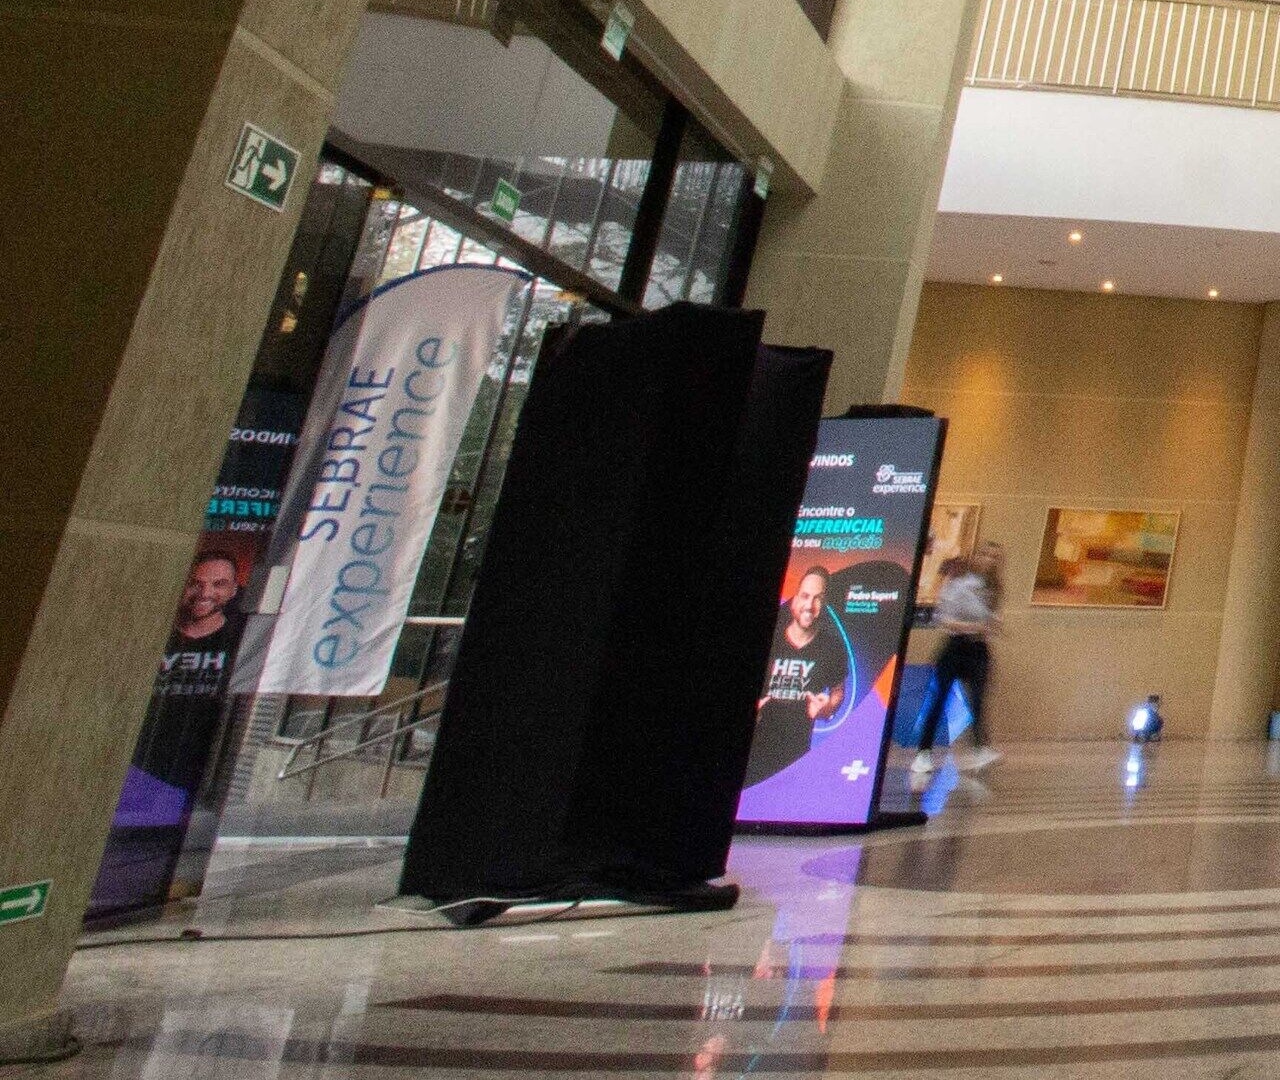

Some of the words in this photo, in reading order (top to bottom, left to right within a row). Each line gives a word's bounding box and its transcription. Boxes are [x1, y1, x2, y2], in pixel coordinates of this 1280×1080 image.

[300, 367, 395, 543] SEBRAE
[893, 475, 922, 484] SEBRAE
[872, 484, 927, 494] experience
[312, 336, 456, 670] experience
[846, 507, 855, 517] o
[804, 538, 821, 547] seu
[771, 658, 816, 677] HEY
